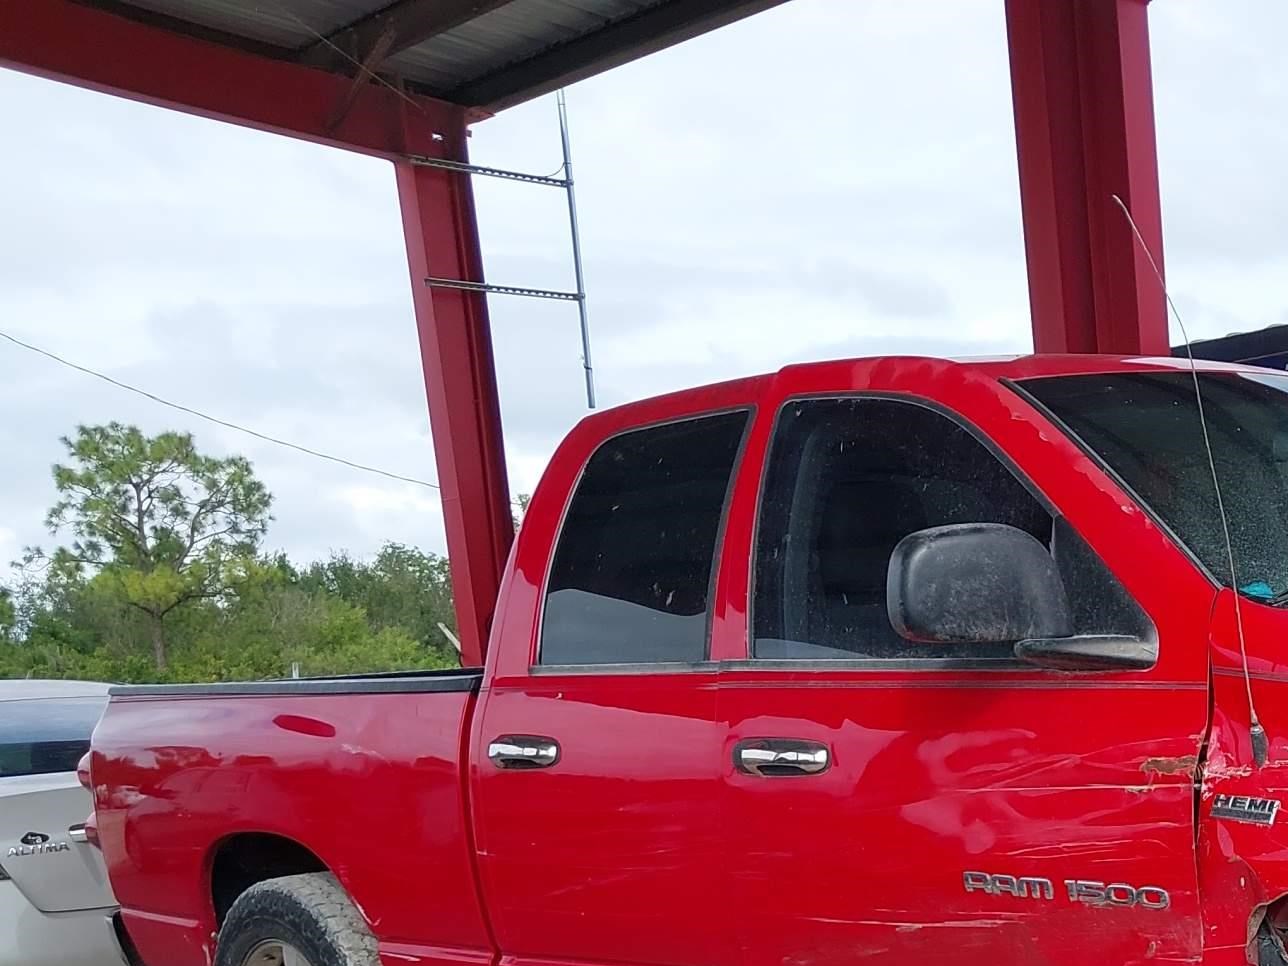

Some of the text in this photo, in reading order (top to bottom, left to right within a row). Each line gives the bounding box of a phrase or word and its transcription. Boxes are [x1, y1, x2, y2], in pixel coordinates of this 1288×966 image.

[1213, 795, 1276, 813] HEMI
[7, 842, 70, 858] ALTIMA
[963, 871, 1170, 910] RAM 1500
